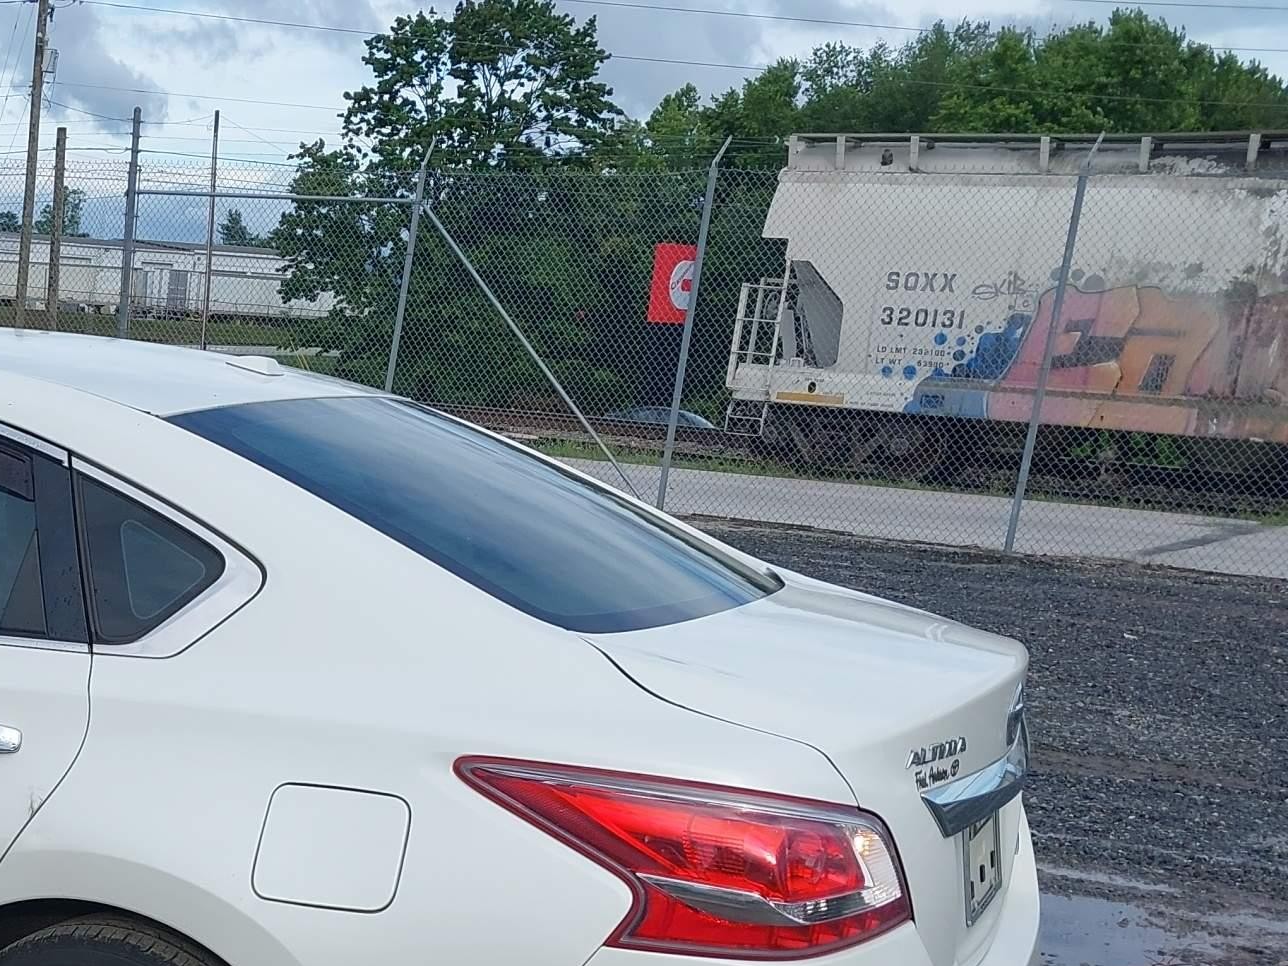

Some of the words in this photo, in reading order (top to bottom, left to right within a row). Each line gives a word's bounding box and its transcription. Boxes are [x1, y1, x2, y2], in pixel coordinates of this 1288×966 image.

[885, 271, 957, 293] SOXX
[880, 306, 965, 329] 320131
[876, 345, 887, 353] LD
[875, 357, 885, 365] LT
